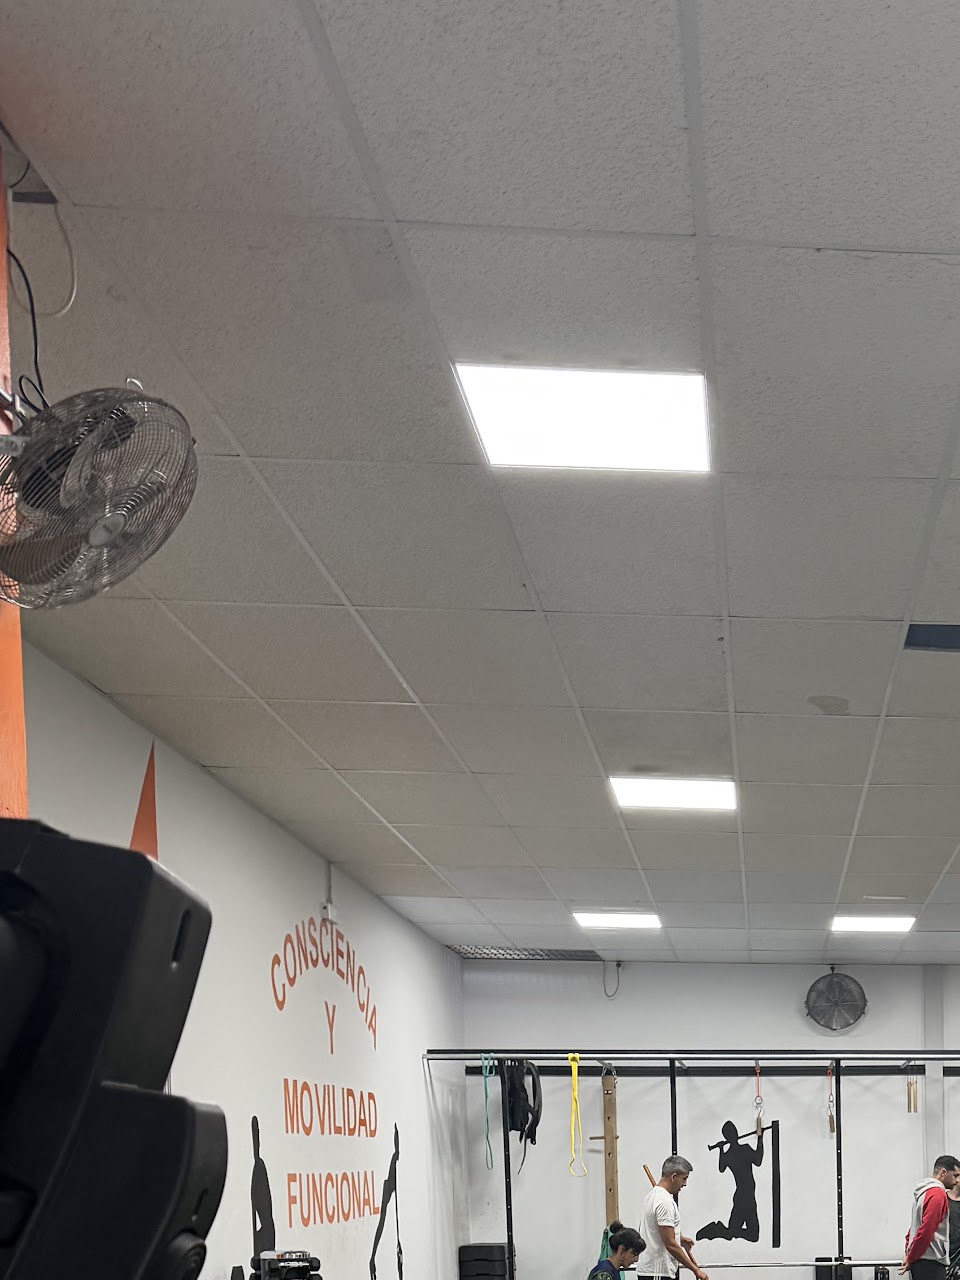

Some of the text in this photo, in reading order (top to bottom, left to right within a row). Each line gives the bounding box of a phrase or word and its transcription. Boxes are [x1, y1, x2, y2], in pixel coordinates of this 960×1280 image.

[271, 916, 377, 1051] CONSCIENCIA
[324, 1000, 336, 1055] Y
[283, 1078, 378, 1138] MOVILIDAD
[287, 1170, 380, 1229] FUNCIONAL
